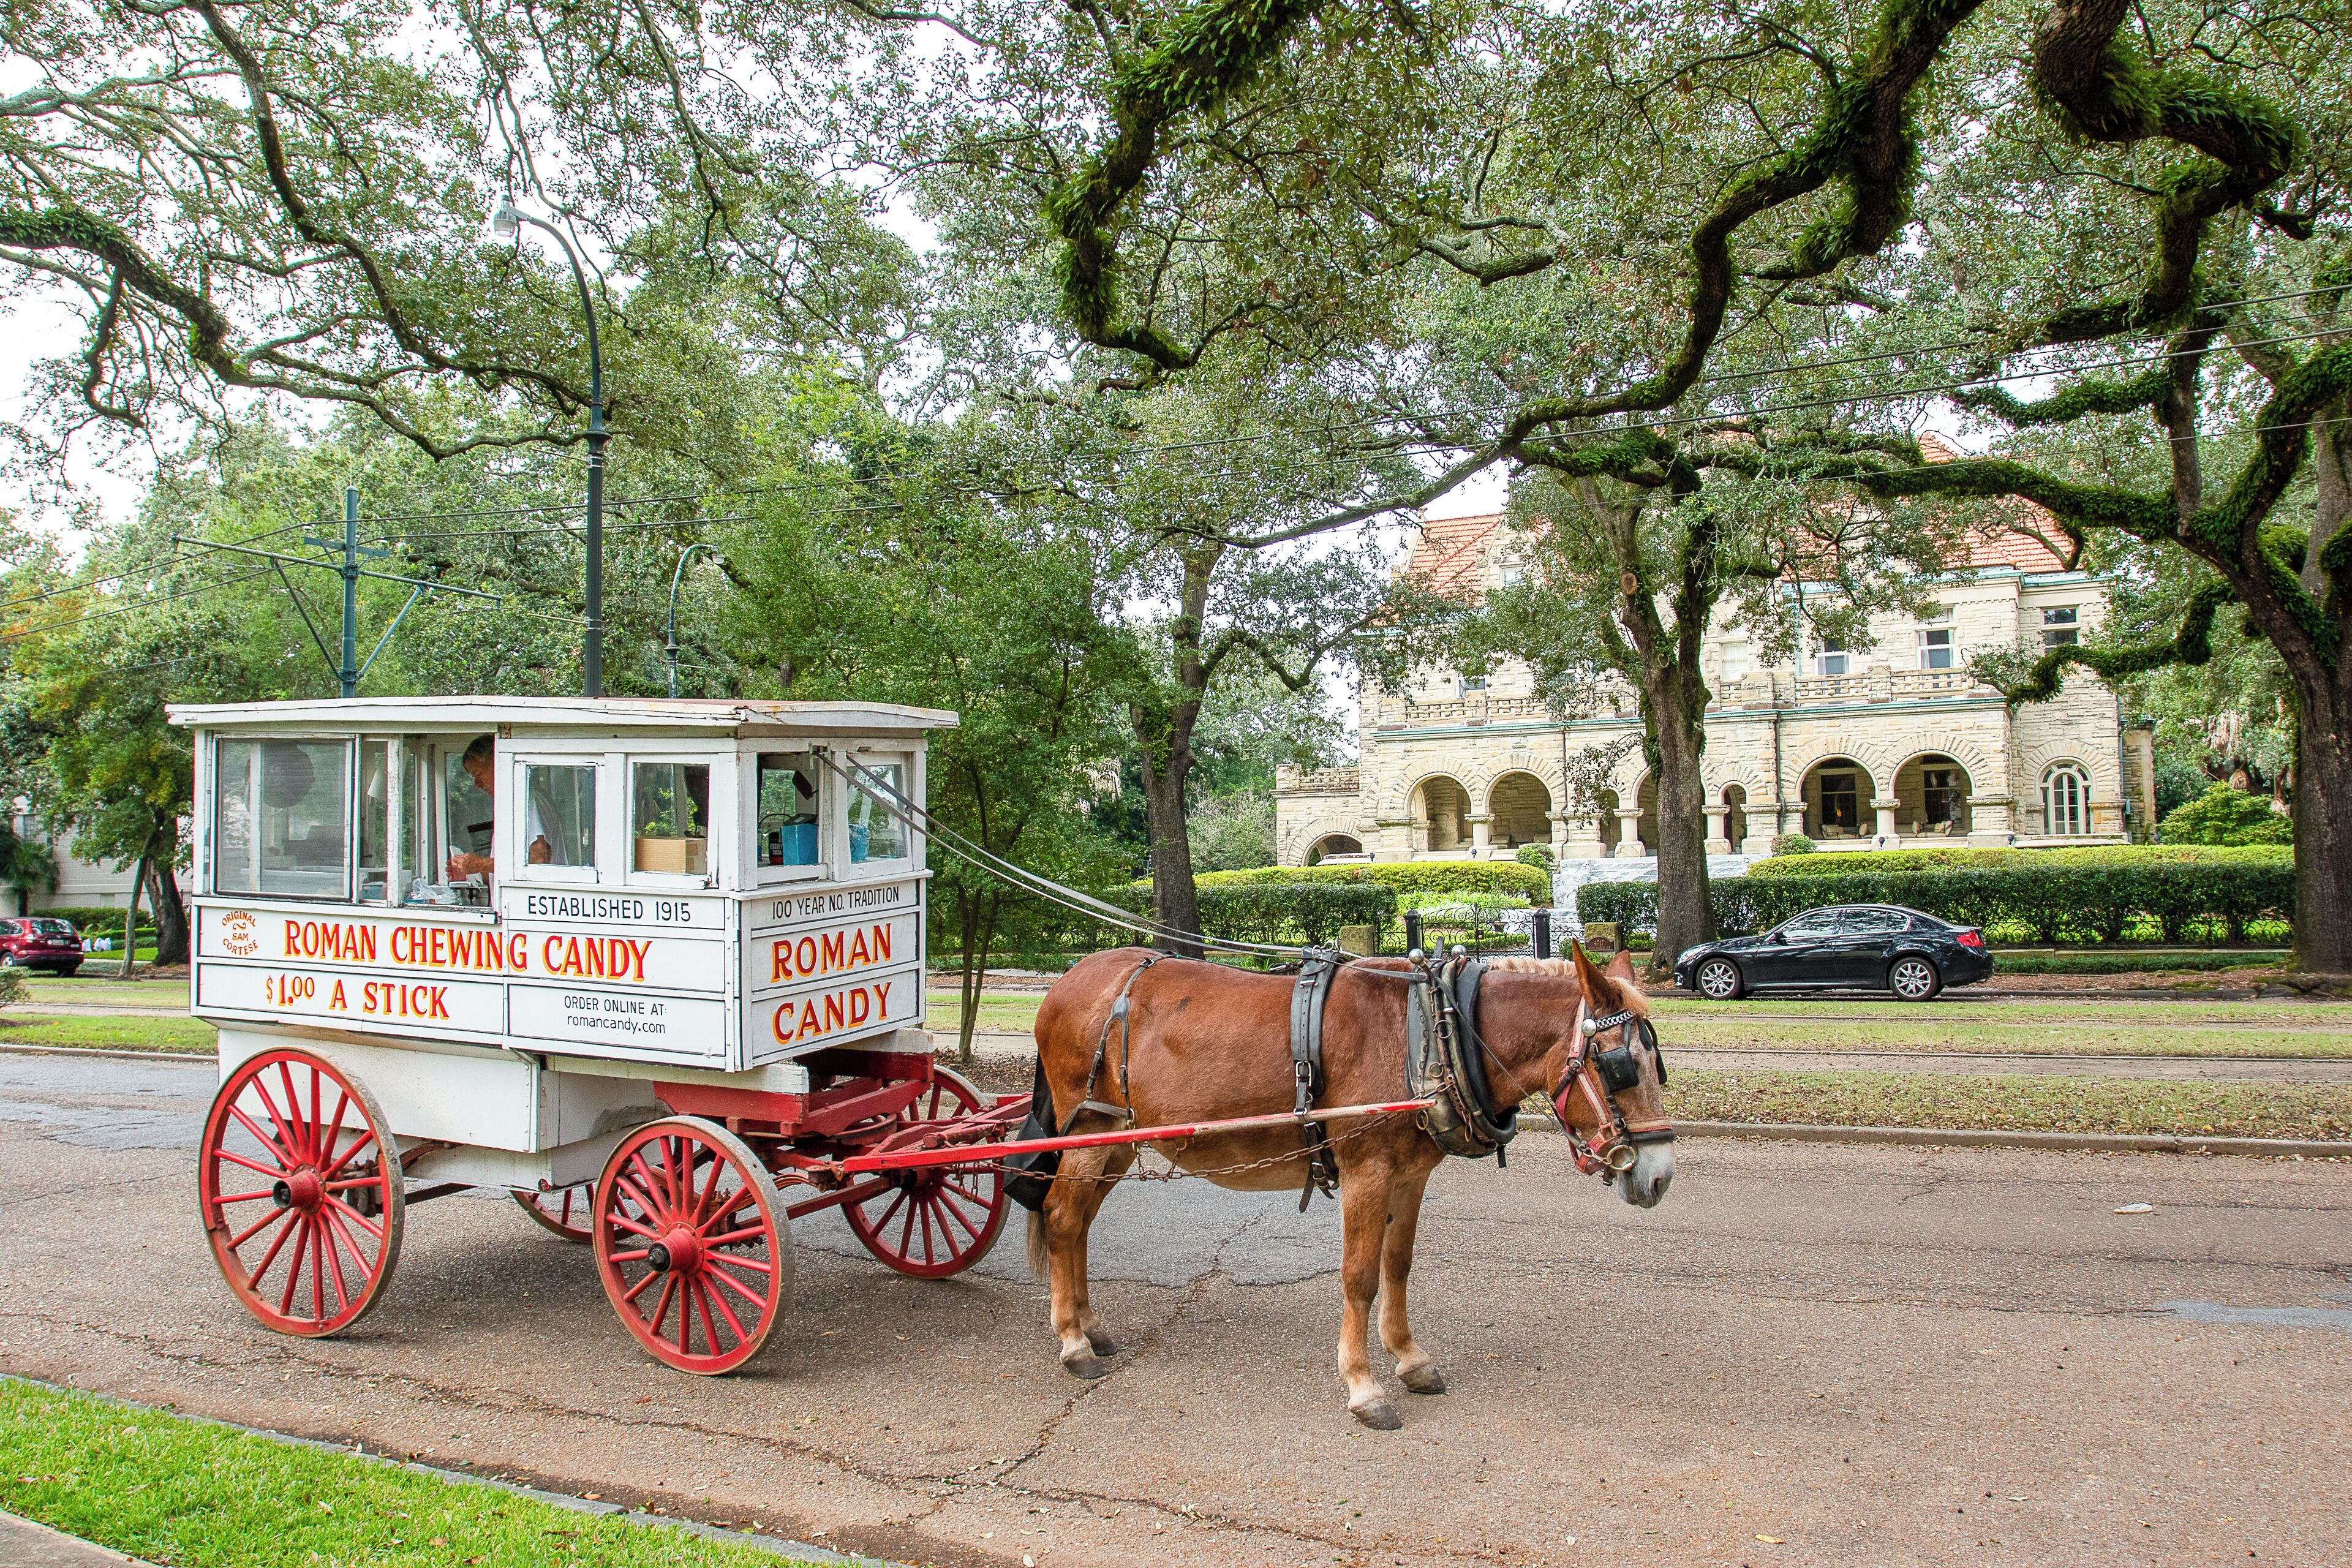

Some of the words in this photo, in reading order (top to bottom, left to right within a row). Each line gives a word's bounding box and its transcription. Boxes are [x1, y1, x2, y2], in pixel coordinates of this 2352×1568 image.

[528, 895, 643, 919] ESTABLISHED
[655, 901, 691, 922] 1915
[772, 900, 792, 919] 100
[797, 896, 824, 916] YEAR
[829, 894, 844, 912] N.O.
[848, 886, 899, 908] TRADITION
[222, 911, 256, 927] ORIGINAL
[222, 938, 259, 956] CORTESE
[232, 932, 249, 941] SAM
[284, 920, 376, 962] ROMAN
[390, 926, 527, 972] CHEWING
[542, 935, 653, 982] CANDY
[771, 922, 891, 983] ROMAN
[265, 973, 315, 1006] $1.00
[329, 979, 348, 1011] A
[362, 981, 450, 1020] STICK
[564, 995, 598, 1011] ORDER
[604, 999, 644, 1014] ONLINE
[650, 1003, 667, 1016] AT:
[567, 1016, 666, 1034] romancandy.com
[772, 981, 892, 1045] CANDY
